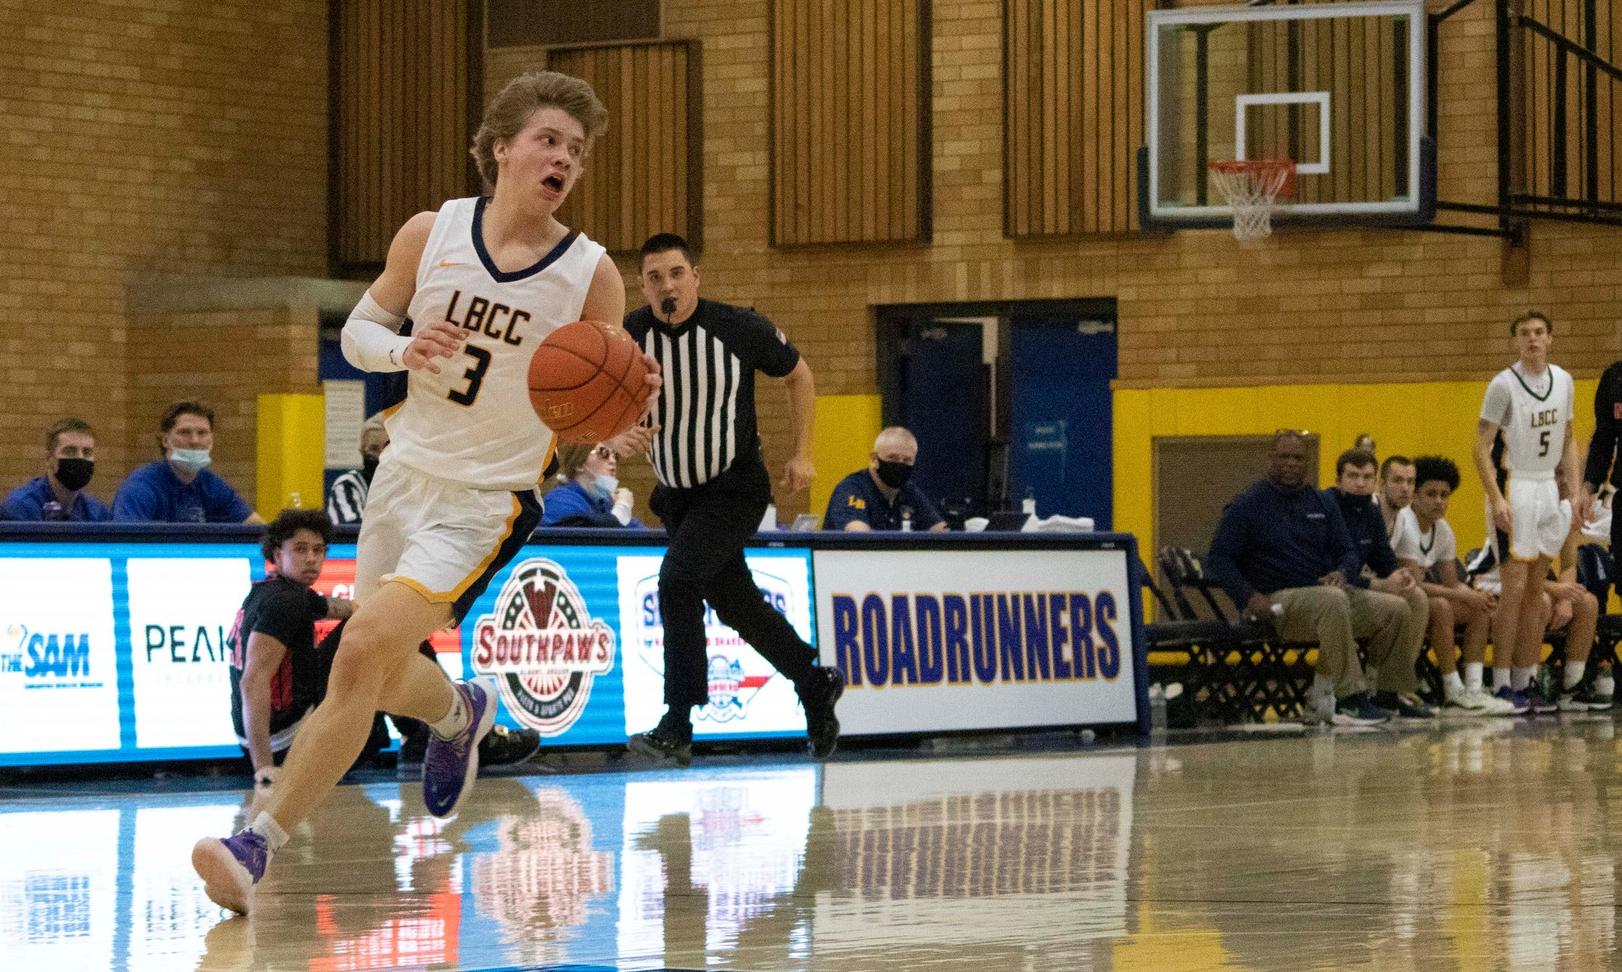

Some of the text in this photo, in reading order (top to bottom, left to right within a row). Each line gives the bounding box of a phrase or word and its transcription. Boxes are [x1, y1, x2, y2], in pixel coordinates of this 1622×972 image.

[445, 290, 531, 346] LBCC
[448, 344, 492, 407] 3
[1531, 408, 1559, 428] LBCC
[1538, 431, 1551, 457] 5
[25, 632, 90, 677] SAM
[476, 625, 611, 668] SOUTHPAW'S
[831, 590, 1123, 690] ROADRUNNERS
[1, 654, 23, 672] THE
